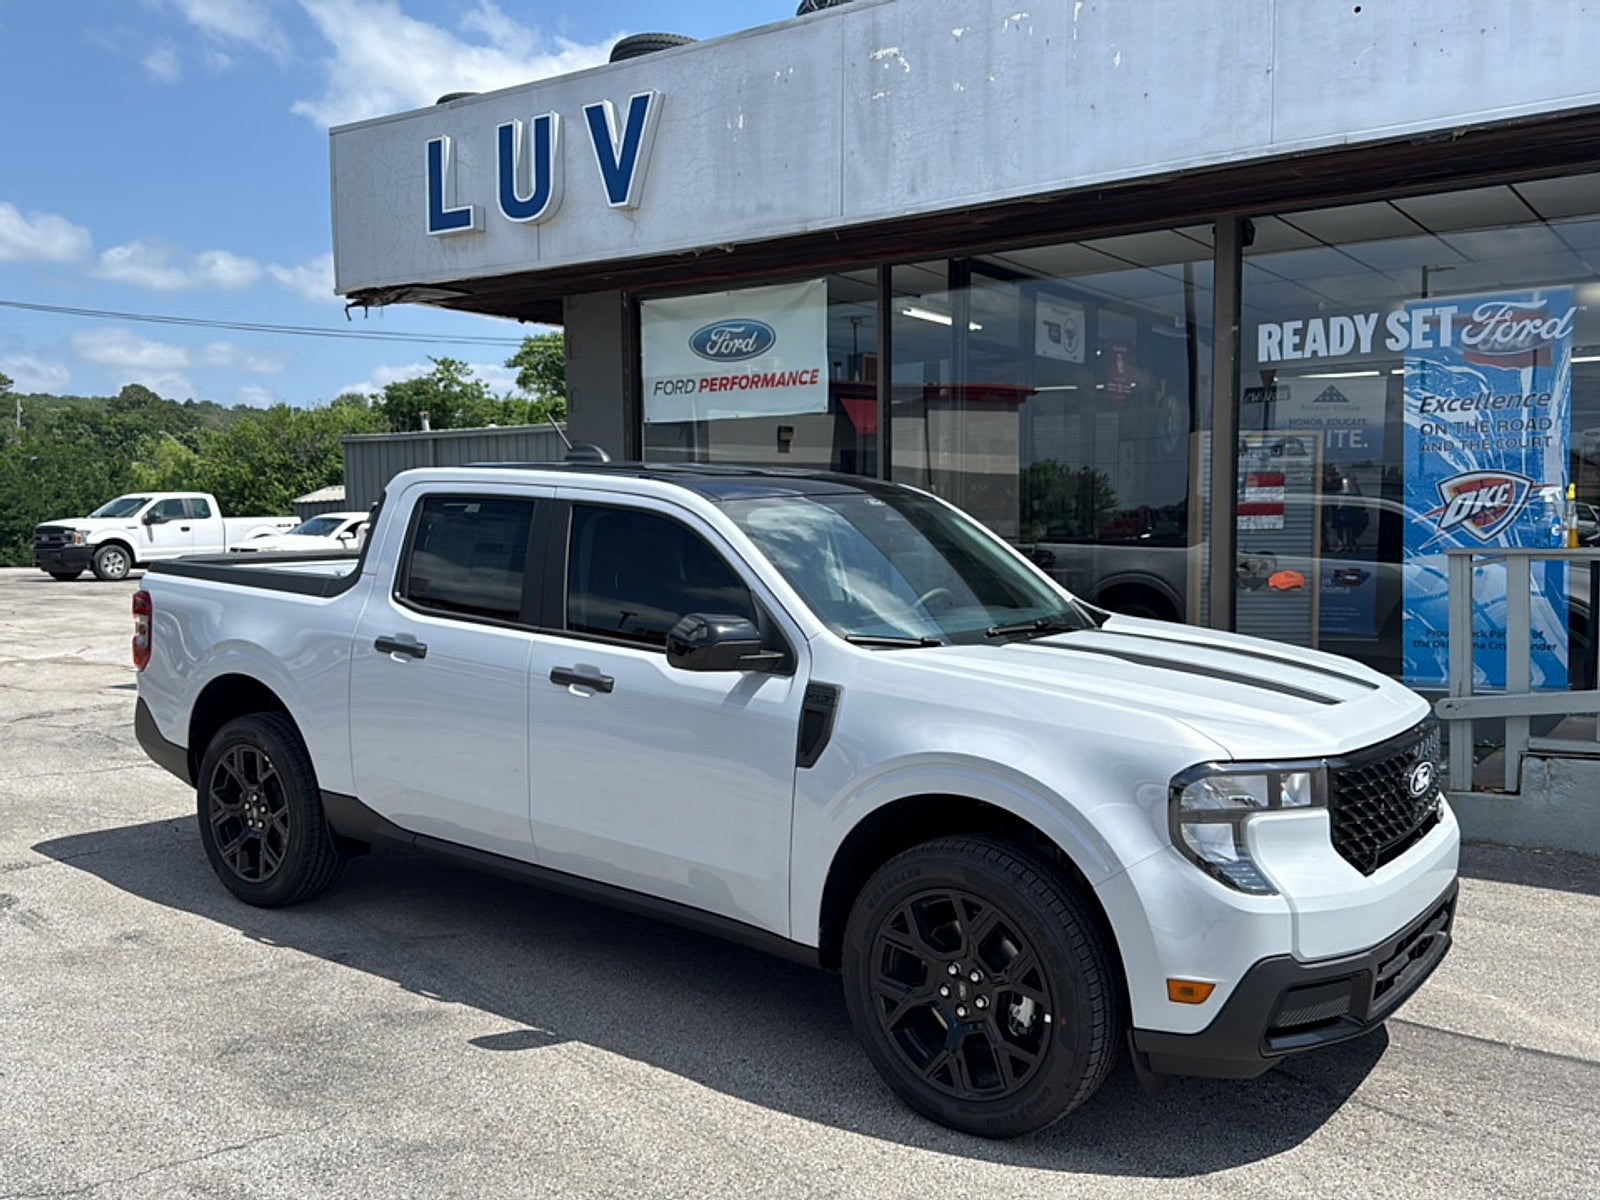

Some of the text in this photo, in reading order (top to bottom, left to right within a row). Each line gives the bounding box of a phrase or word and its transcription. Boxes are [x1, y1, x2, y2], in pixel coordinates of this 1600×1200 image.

[426, 89, 663, 236] LUV
[705, 325, 758, 355] Ford
[1258, 299, 1577, 363] READY SET Ford
[653, 368, 820, 397] FORD PERFORMANCE
[1419, 392, 1552, 414] Excellence
[1420, 416, 1553, 436] ON THE ROAD
[1420, 435, 1553, 453] AND THE COURT
[1440, 482, 1512, 529] OKC
